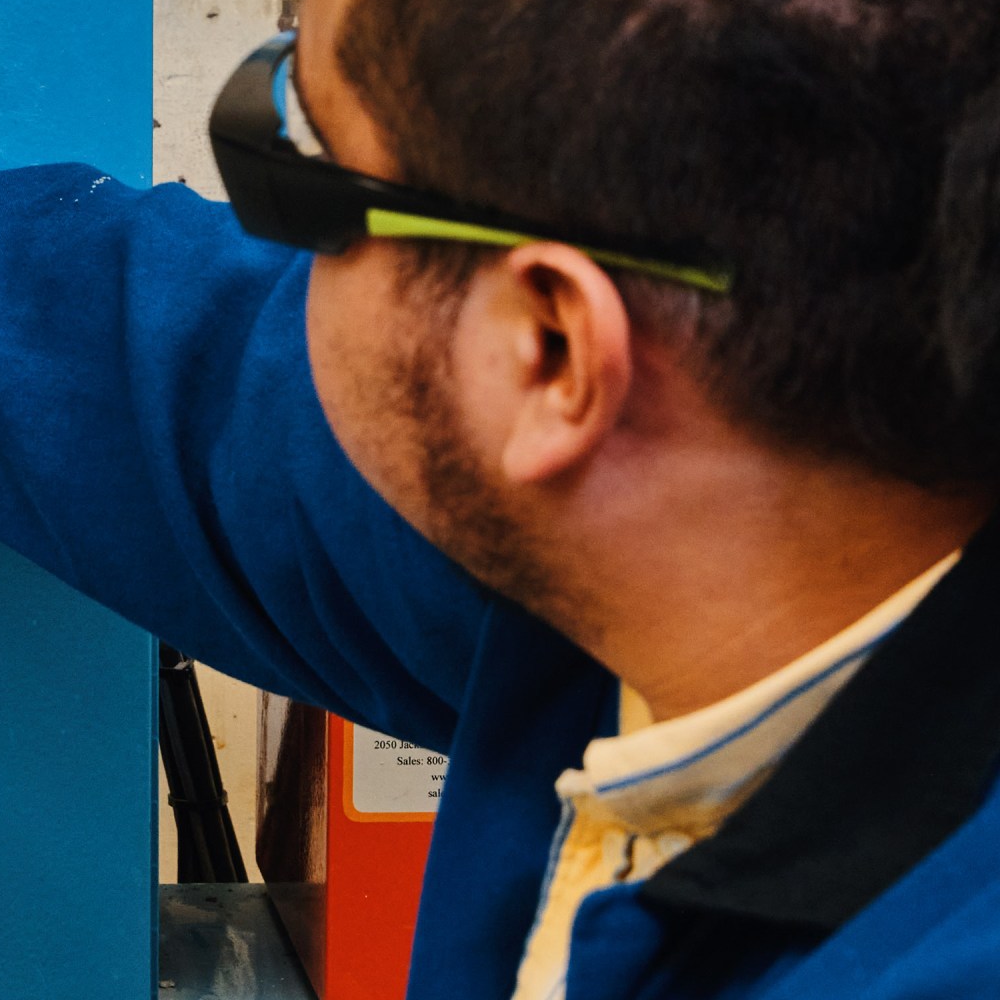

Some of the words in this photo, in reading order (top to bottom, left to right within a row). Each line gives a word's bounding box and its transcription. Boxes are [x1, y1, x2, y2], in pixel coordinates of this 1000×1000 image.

[374, 740, 397, 750] 2050
[396, 756, 424, 766] Sales:
[426, 756, 450, 766] 800-
